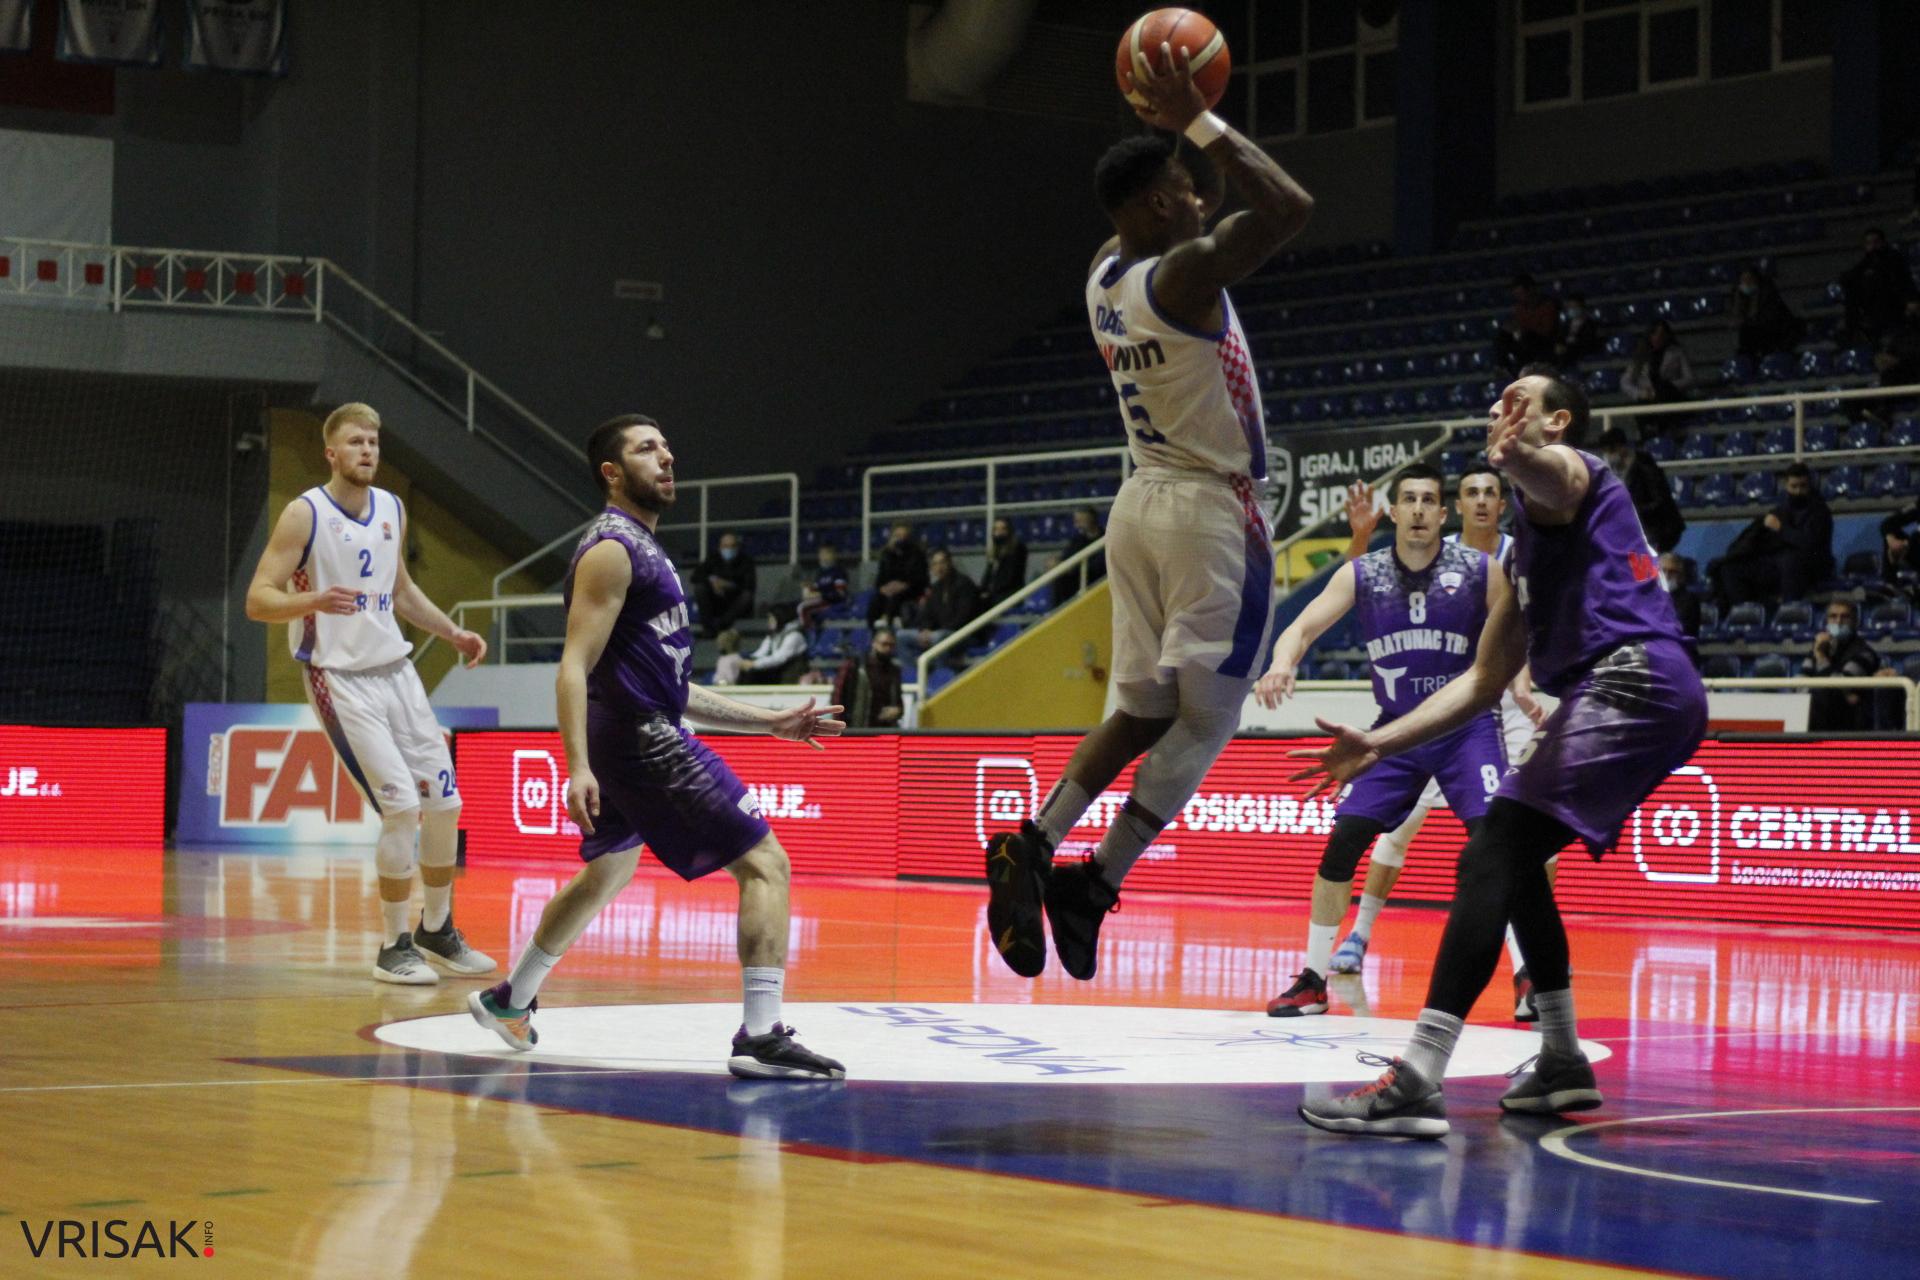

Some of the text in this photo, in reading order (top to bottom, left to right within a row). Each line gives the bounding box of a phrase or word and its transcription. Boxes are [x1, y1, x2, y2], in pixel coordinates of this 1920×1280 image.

[1119, 382, 1166, 444] 5
[1299, 449, 1360, 478] IGRAJ,
[358, 548, 373, 578] 2
[1409, 591, 1426, 624] 8
[1480, 764, 1500, 794] 8
[1730, 805, 1920, 854] CENTRAL
